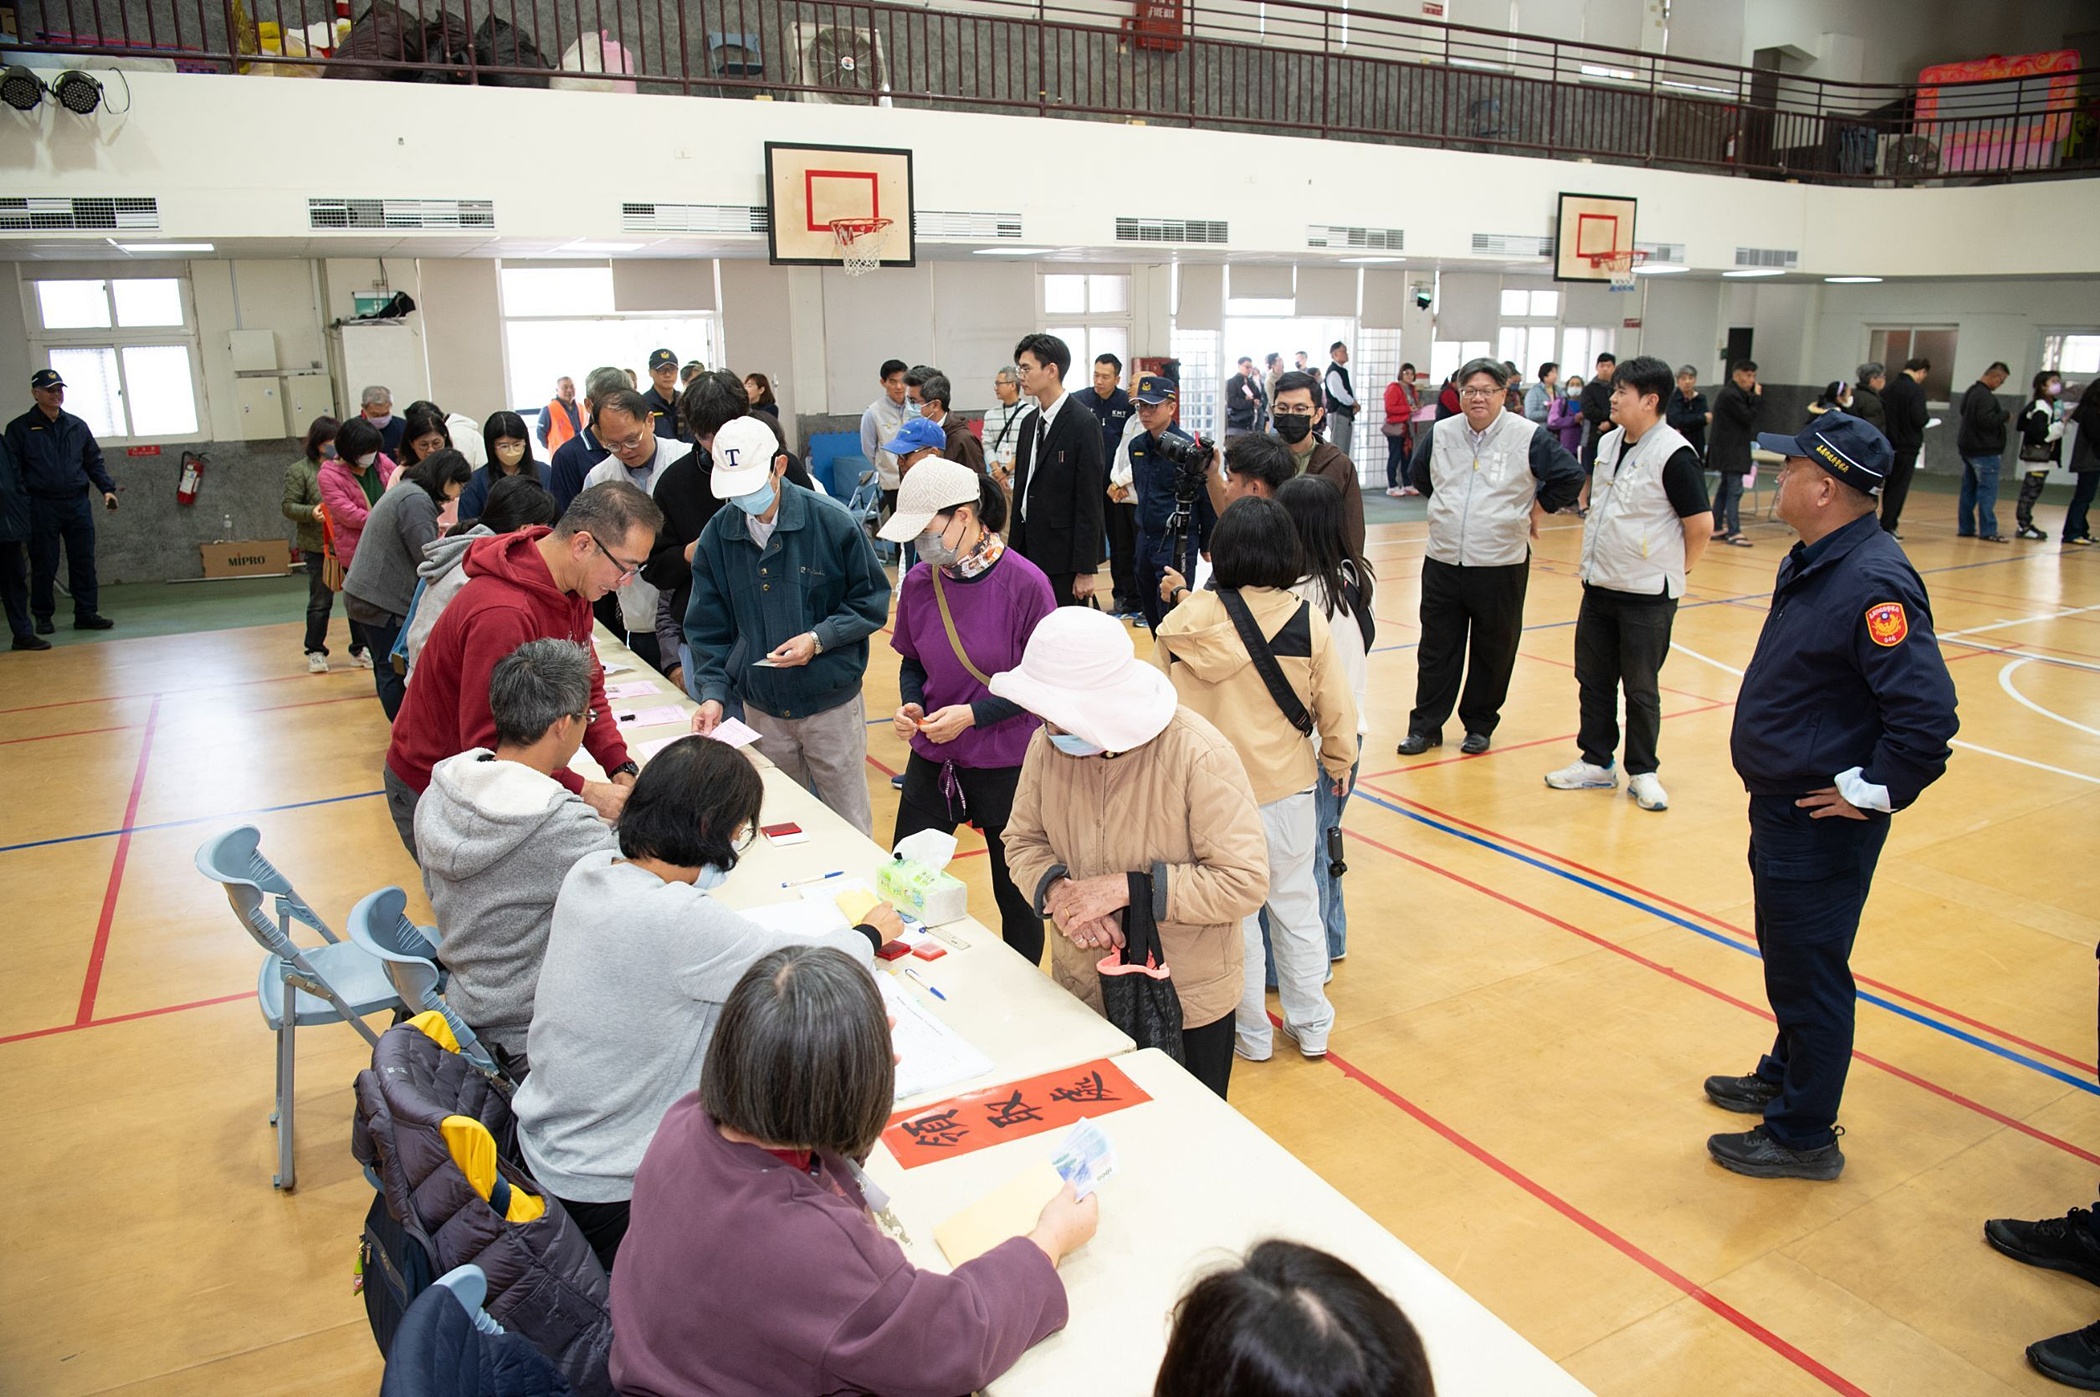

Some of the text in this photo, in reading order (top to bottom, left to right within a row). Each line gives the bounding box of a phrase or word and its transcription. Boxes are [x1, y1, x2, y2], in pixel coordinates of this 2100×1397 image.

[725, 448, 740, 466] T
[228, 553, 266, 567] MIPRO
[901, 1070, 1123, 1147] 領取處
